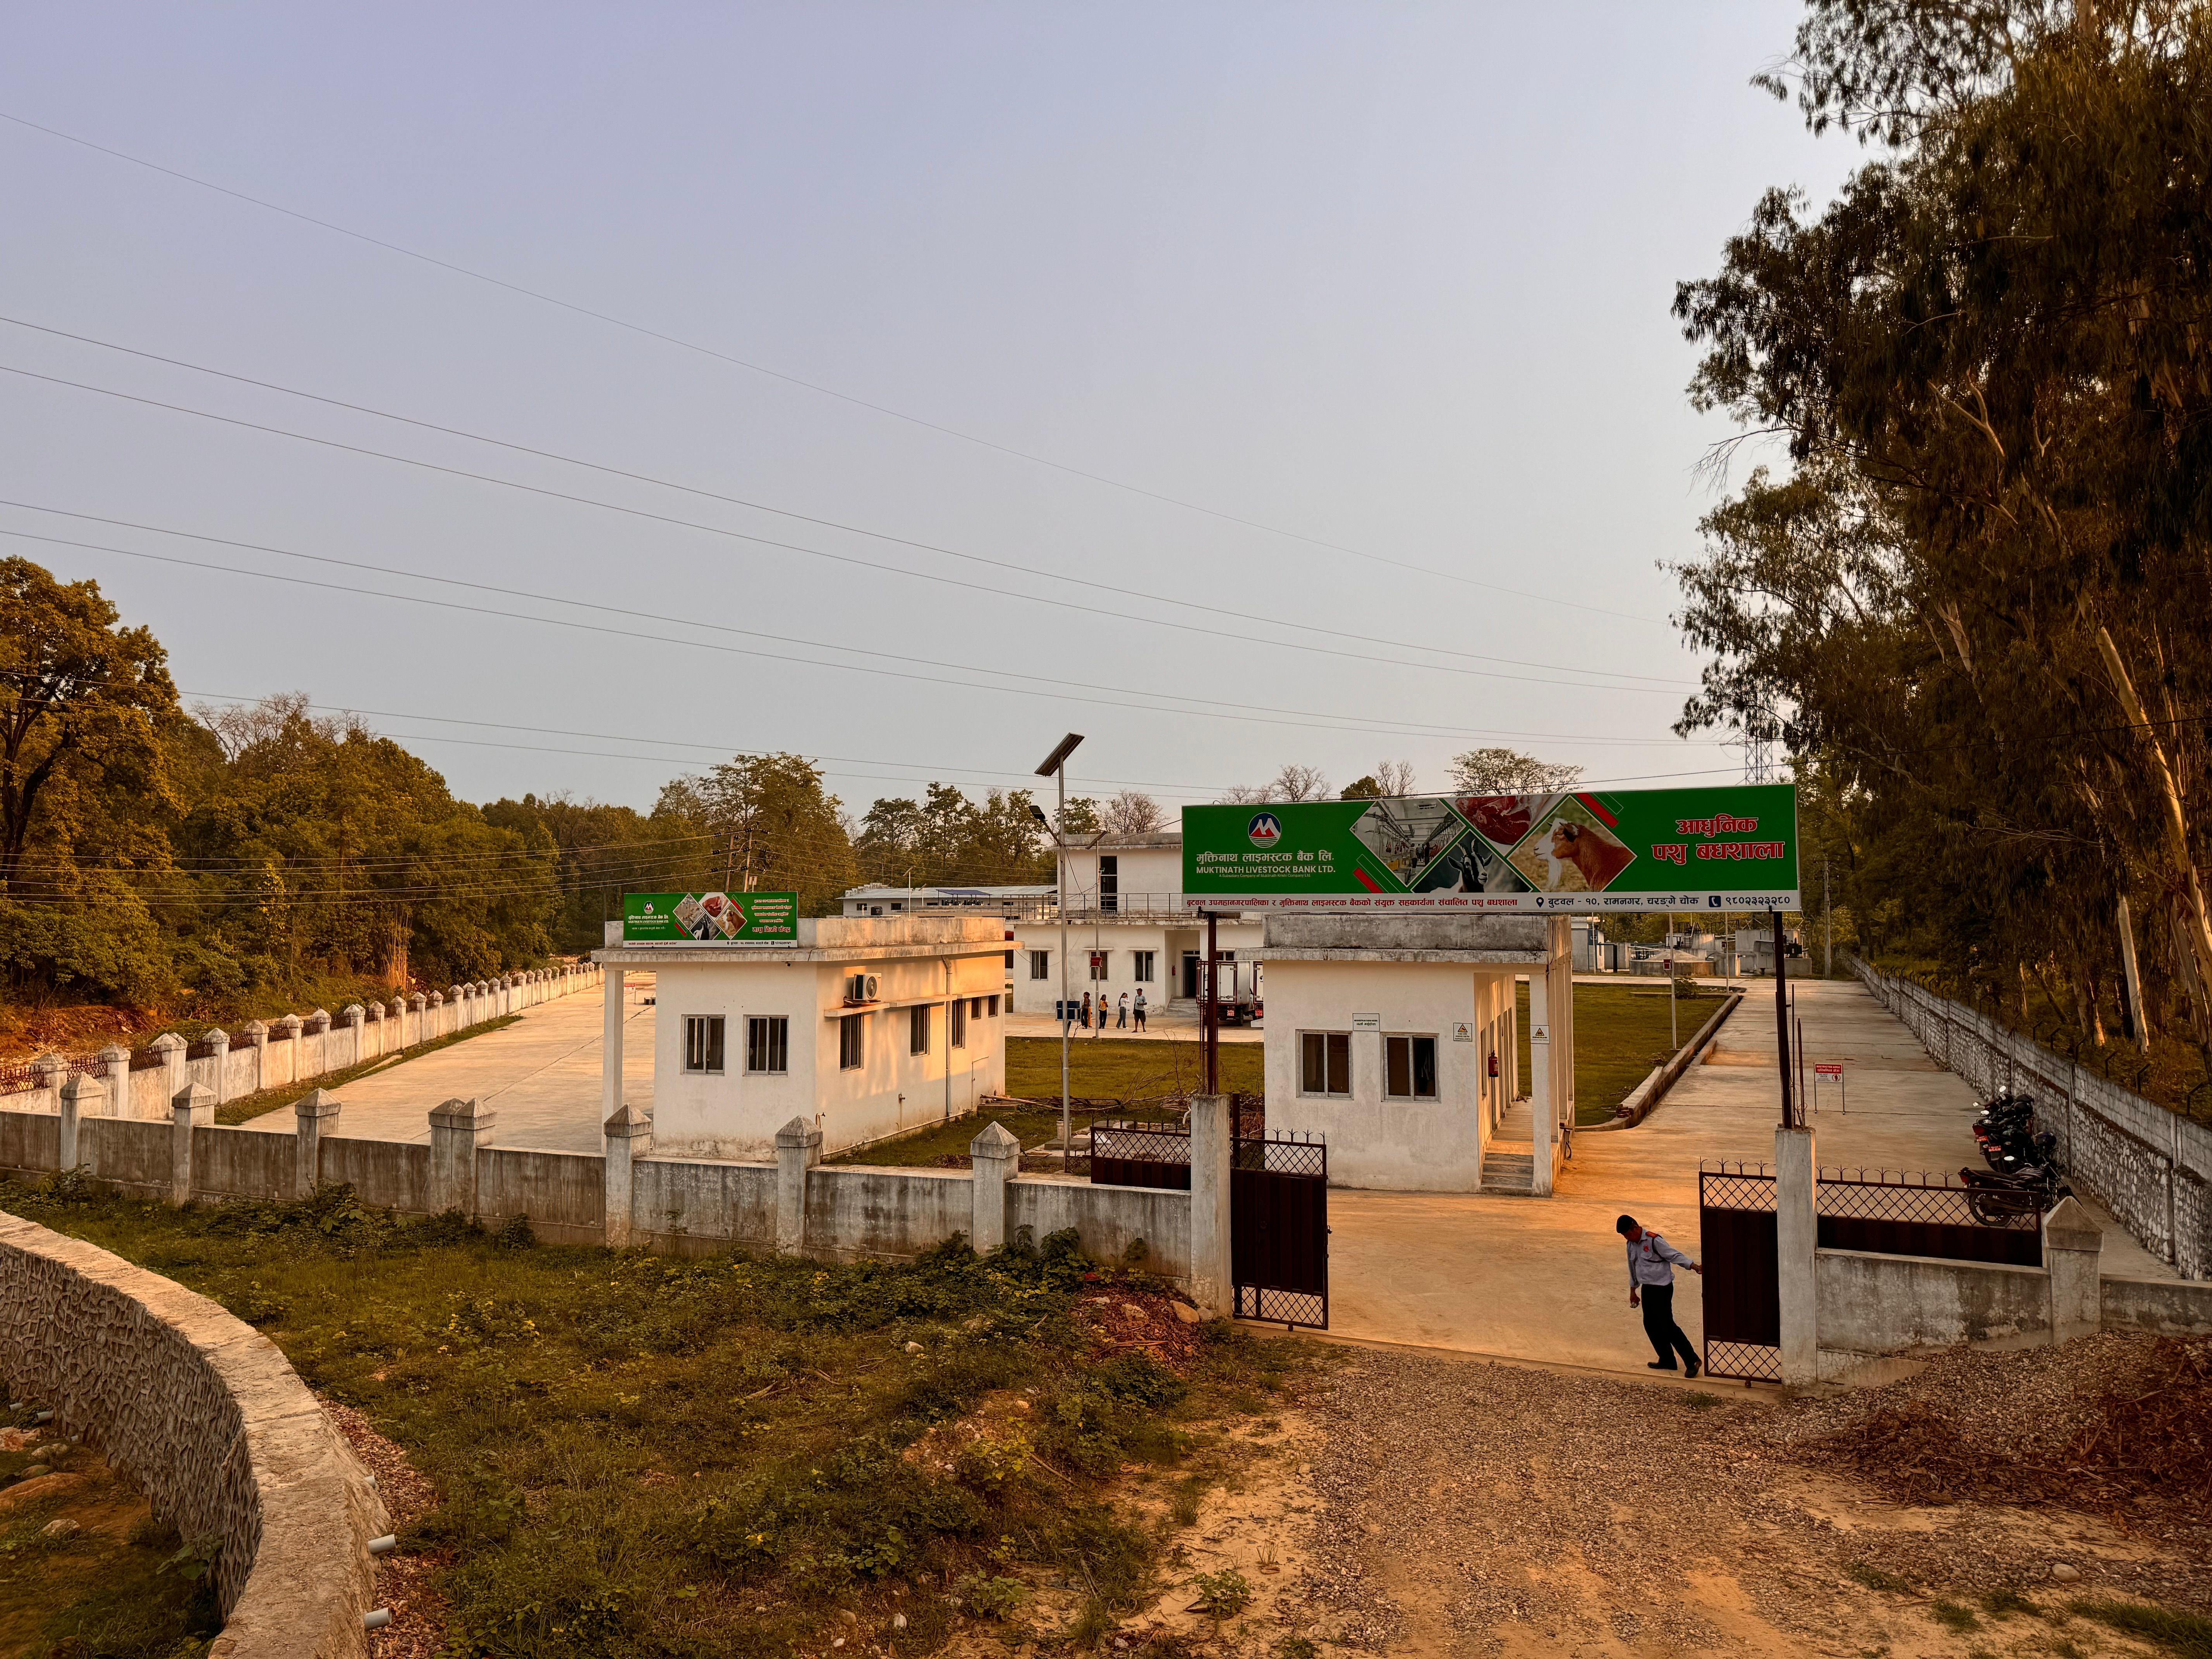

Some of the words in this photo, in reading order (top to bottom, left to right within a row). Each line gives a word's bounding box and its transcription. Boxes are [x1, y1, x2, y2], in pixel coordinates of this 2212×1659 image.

[1676, 813, 1759, 838] आधुनिक
[1196, 851, 1238, 864] मुक्तिनाथ
[1242, 853, 1293, 863] लाइभस्टक
[1318, 850, 1334, 861] लि.
[1652, 844, 1688, 865] पशु
[1279, 898, 1309, 907] मुक्तिनाथ
[1374, 898, 1395, 907] संयुक्त
[1398, 898, 1434, 906] सहकार्यमा
[1438, 898, 1468, 906] संचालित
[1548, 898, 1575, 908] बुटवल
[1603, 898, 1643, 906] रामनगर,
[1679, 895, 1699, 904] चोक
[1726, 896, 1790, 905] ९८०२३२३२८०
